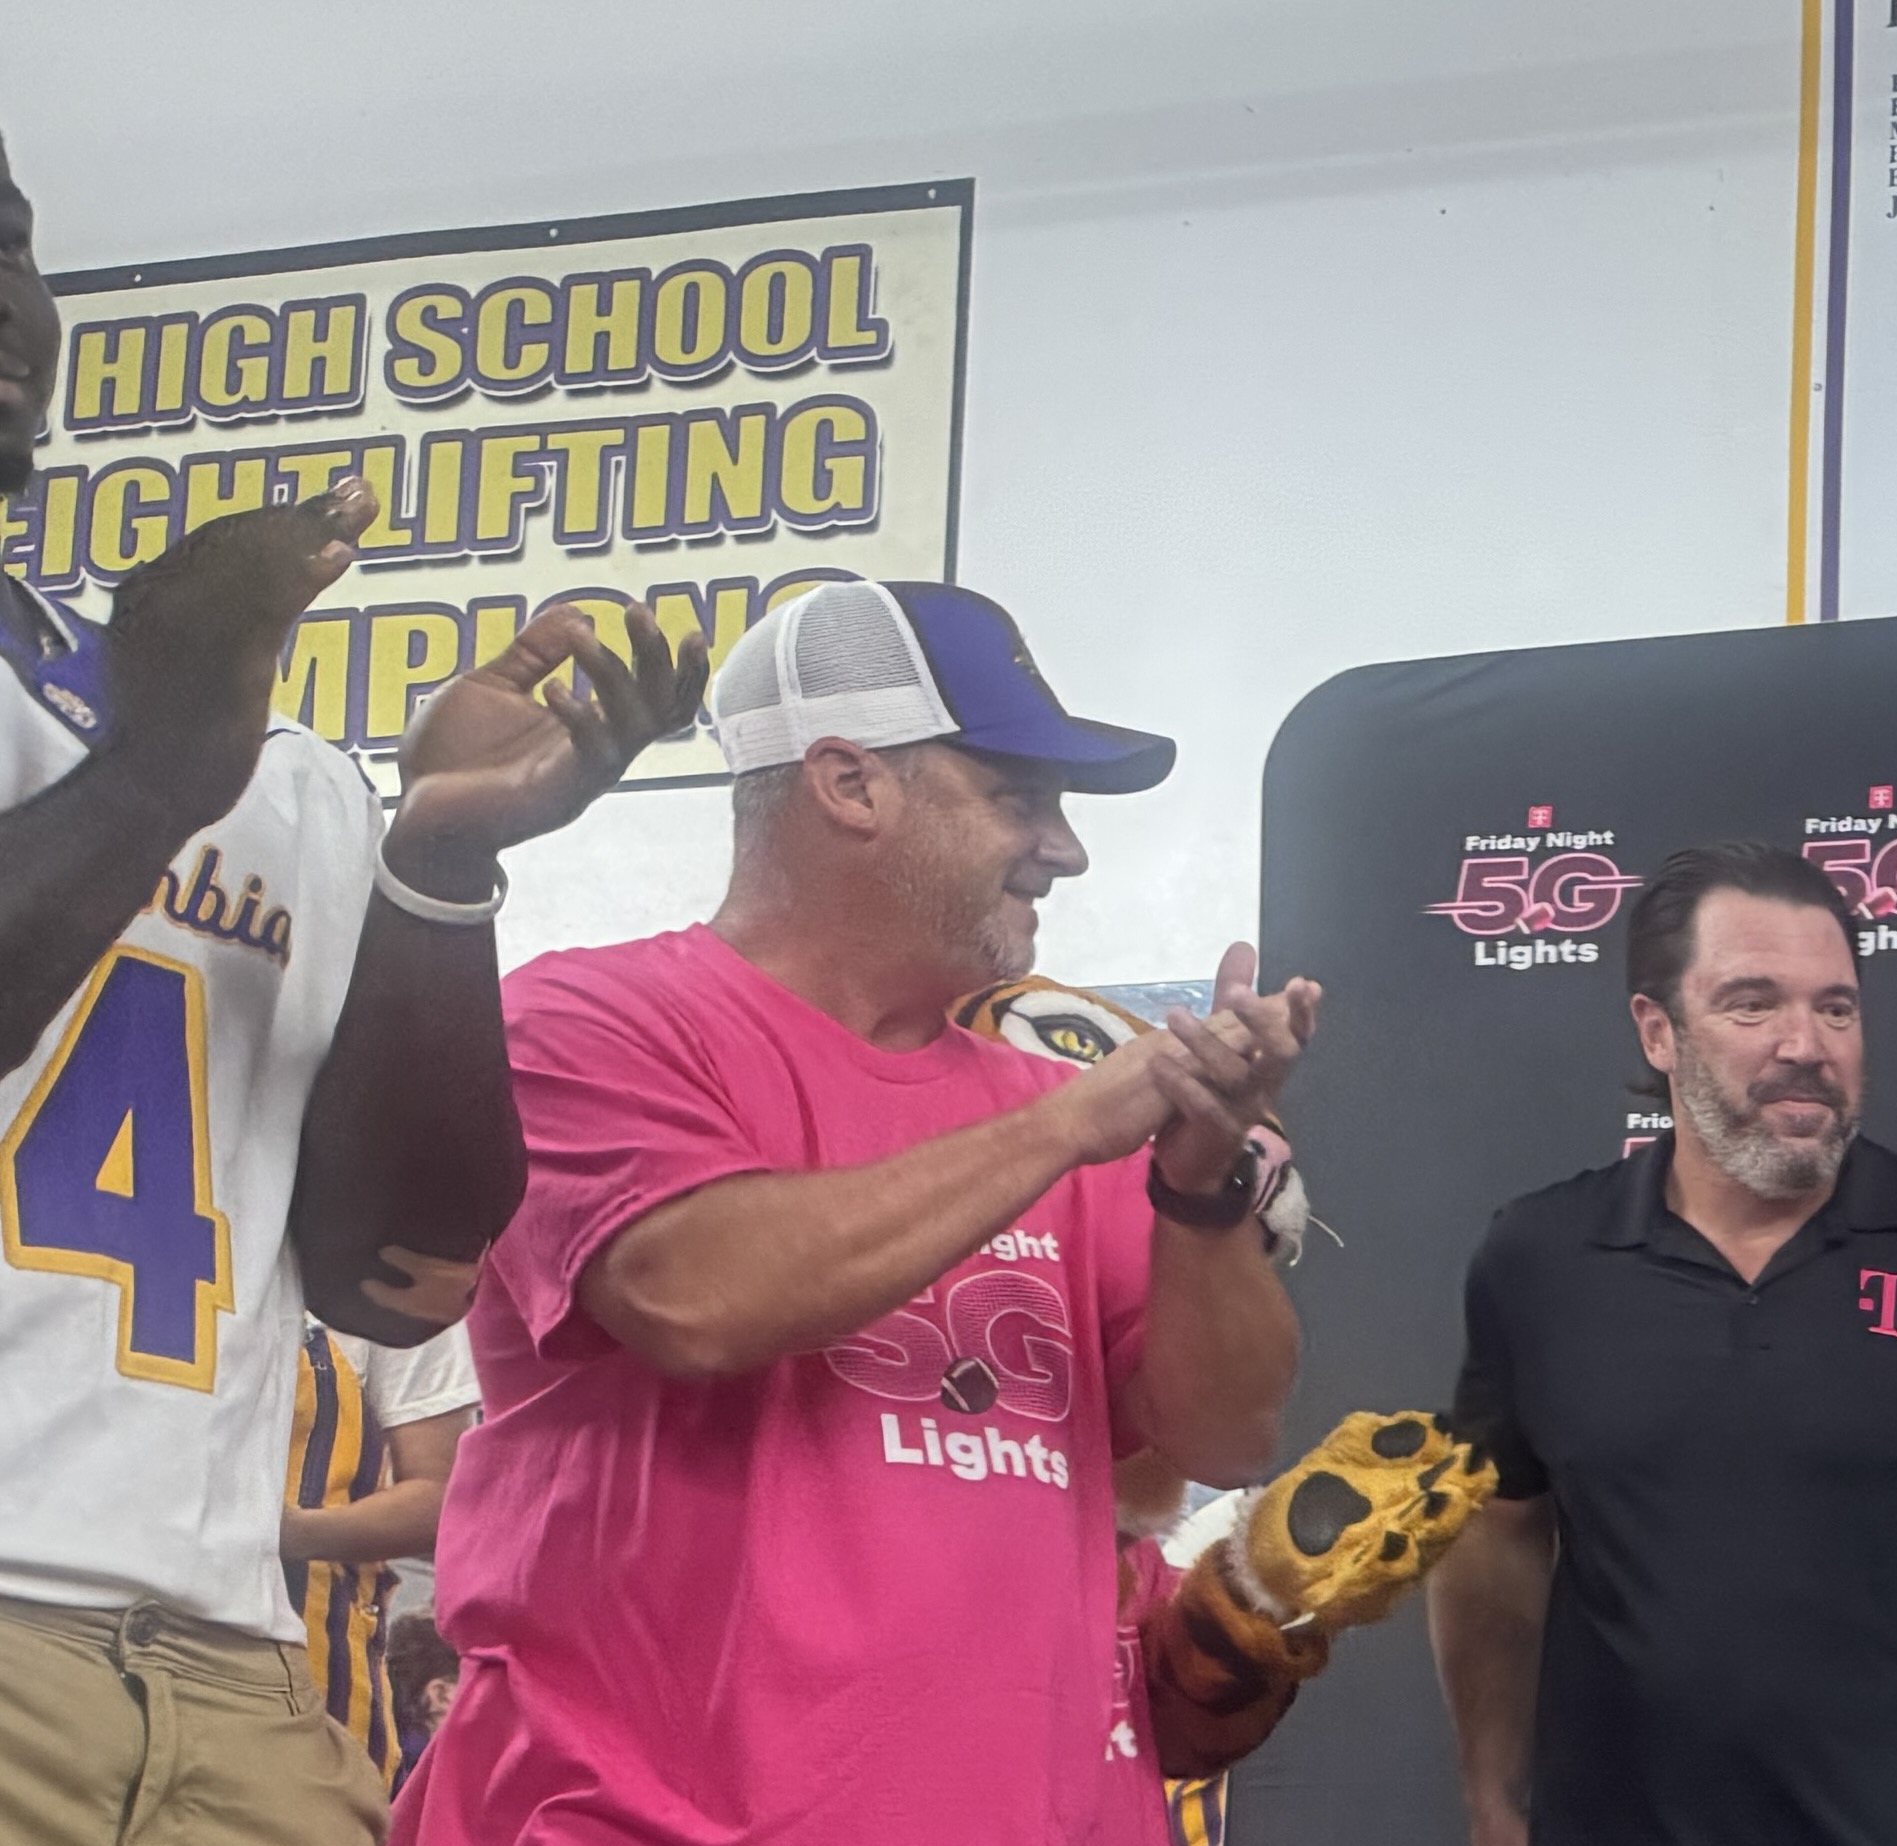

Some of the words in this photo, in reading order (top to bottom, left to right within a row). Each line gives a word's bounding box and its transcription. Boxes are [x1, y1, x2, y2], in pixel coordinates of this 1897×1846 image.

[64, 293, 368, 432] HIGH
[386, 244, 892, 404] SCHOOL
[0, 394, 882, 590] IGHTLIFTING
[1466, 833, 1541, 852] Friday
[1546, 830, 1614, 849] Night
[1804, 816, 1883, 834] Friday
[1444, 853, 1630, 935] 5G
[1475, 938, 1599, 969] Lights
[2, 943, 235, 1393] 4
[881, 1411, 1071, 1490] Lights
